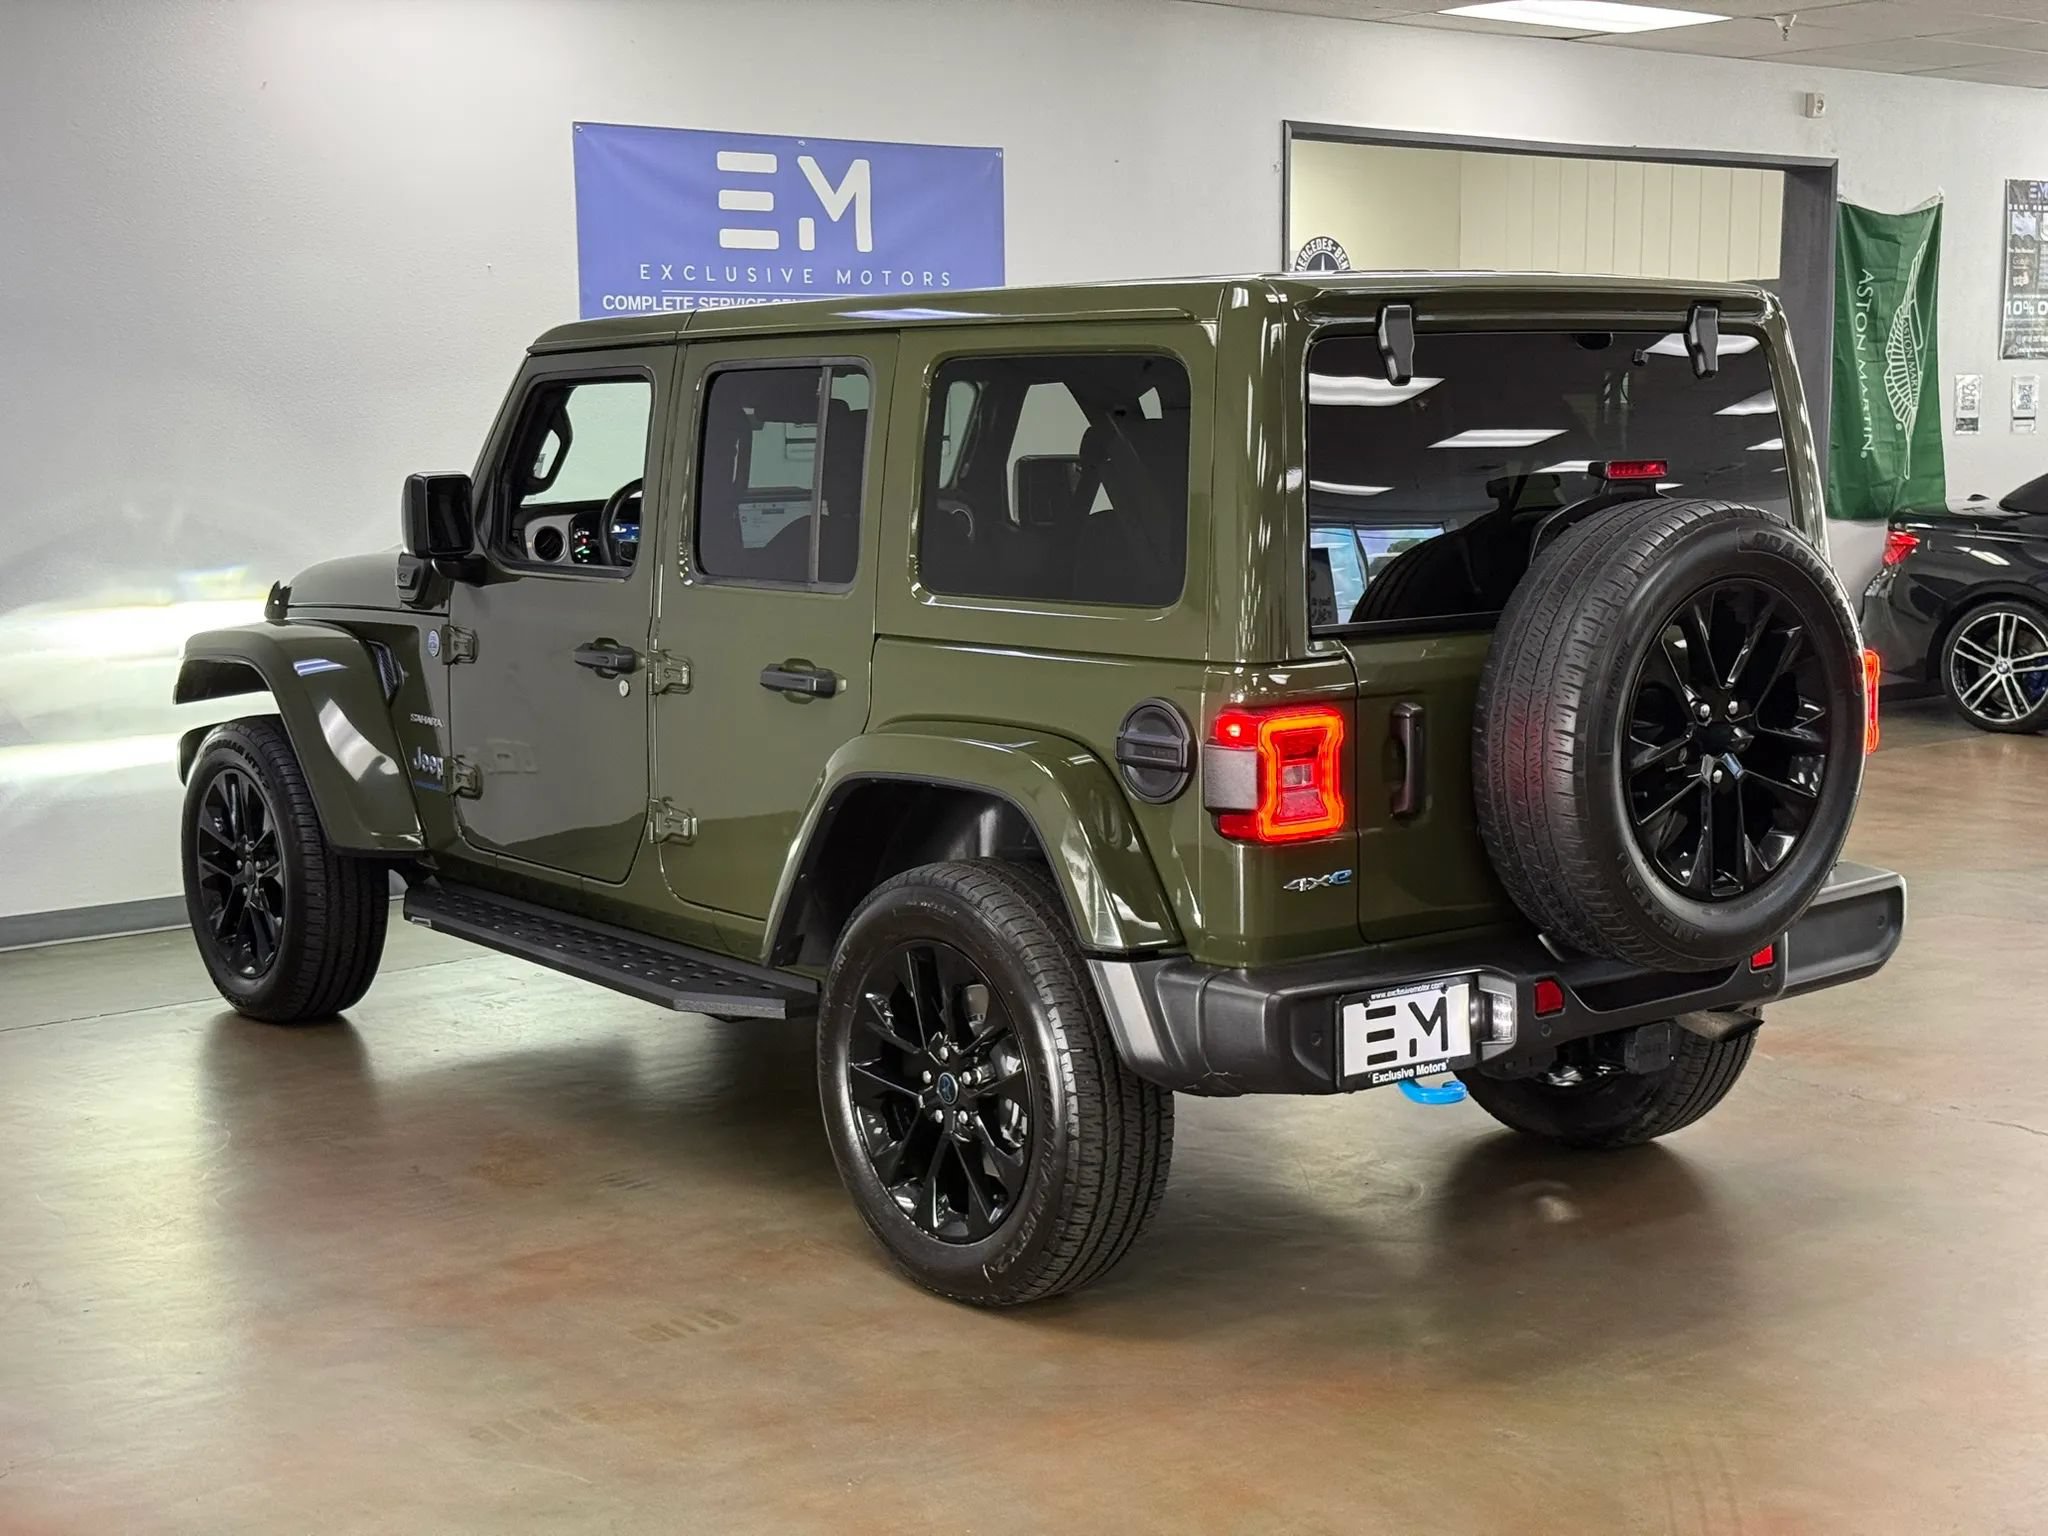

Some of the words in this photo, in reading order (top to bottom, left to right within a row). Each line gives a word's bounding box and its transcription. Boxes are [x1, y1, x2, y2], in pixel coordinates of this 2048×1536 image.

[717, 151, 873, 252] EM
[1295, 238, 1350, 272] MERCEDES-BEN
[640, 263, 814, 284] EXCLUSIVE
[836, 269, 952, 287] MOTORS
[602, 294, 695, 311] COMPLETE
[1854, 268, 1875, 351] ASTON
[1902, 319, 1914, 359] ASTON
[1856, 359, 1875, 451] MARTIN
[410, 713, 444, 728] SAHARA
[413, 746, 444, 780] Jeep
[1365, 996, 1449, 1066] EM
